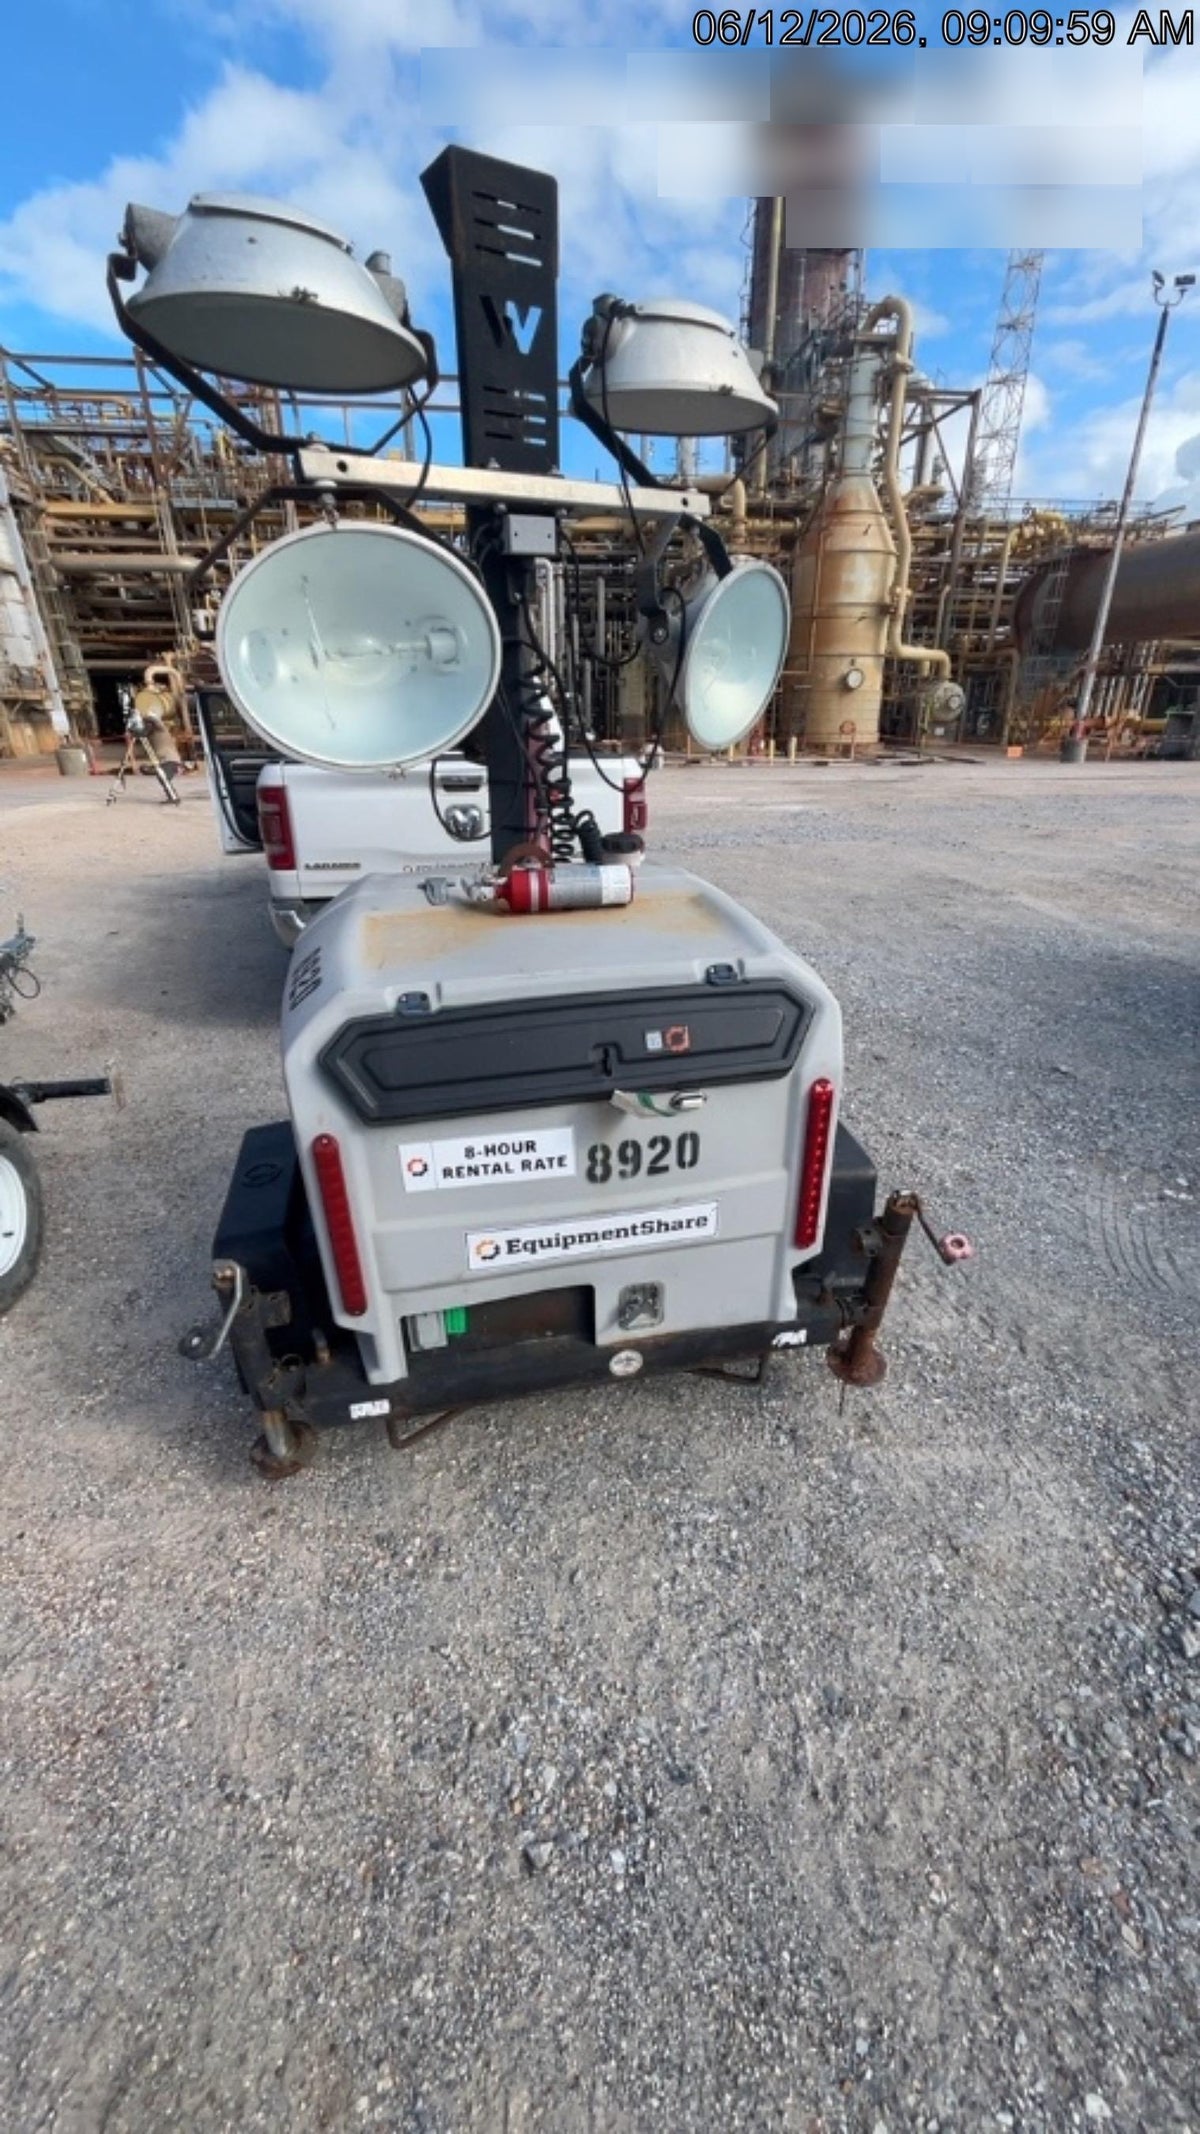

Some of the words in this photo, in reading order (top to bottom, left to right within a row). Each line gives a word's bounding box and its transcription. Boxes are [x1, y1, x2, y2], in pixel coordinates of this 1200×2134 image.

[464, 1140, 537, 1160] 8-HOUR
[585, 1130, 700, 1184] 8920
[442, 1163, 515, 1179] RENTAL
[521, 1155, 568, 1171] RATE
[506, 1215, 708, 1255] EquipmentShare
